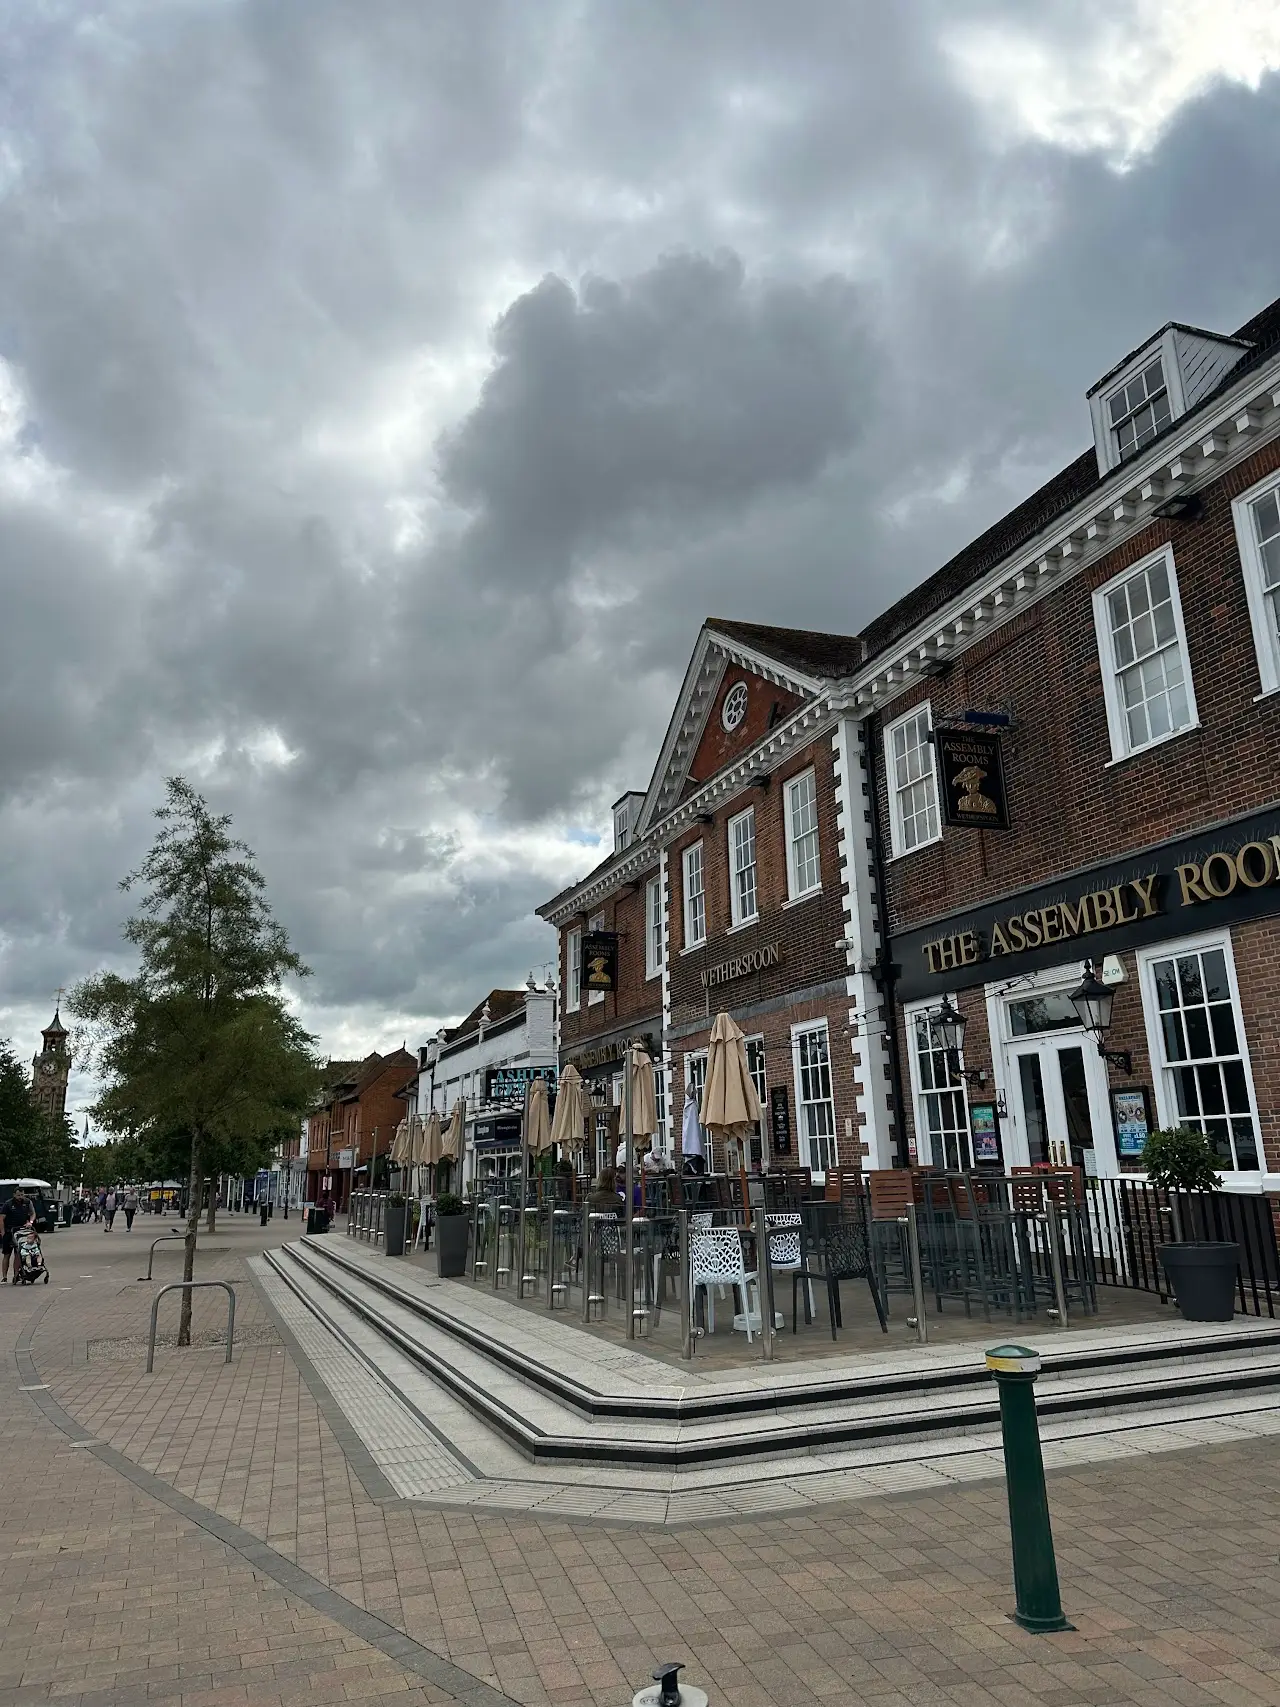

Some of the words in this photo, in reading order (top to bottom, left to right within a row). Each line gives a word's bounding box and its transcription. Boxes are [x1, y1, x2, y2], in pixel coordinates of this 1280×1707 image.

[943, 742, 995, 755] ASSEMBLY
[952, 753, 989, 764] ROOMS
[922, 930, 978, 973] THE
[989, 874, 1159, 958] ASSEMBLY
[1174, 835, 1280, 906] ROO
[700, 941, 780, 988] WETHERSPOON
